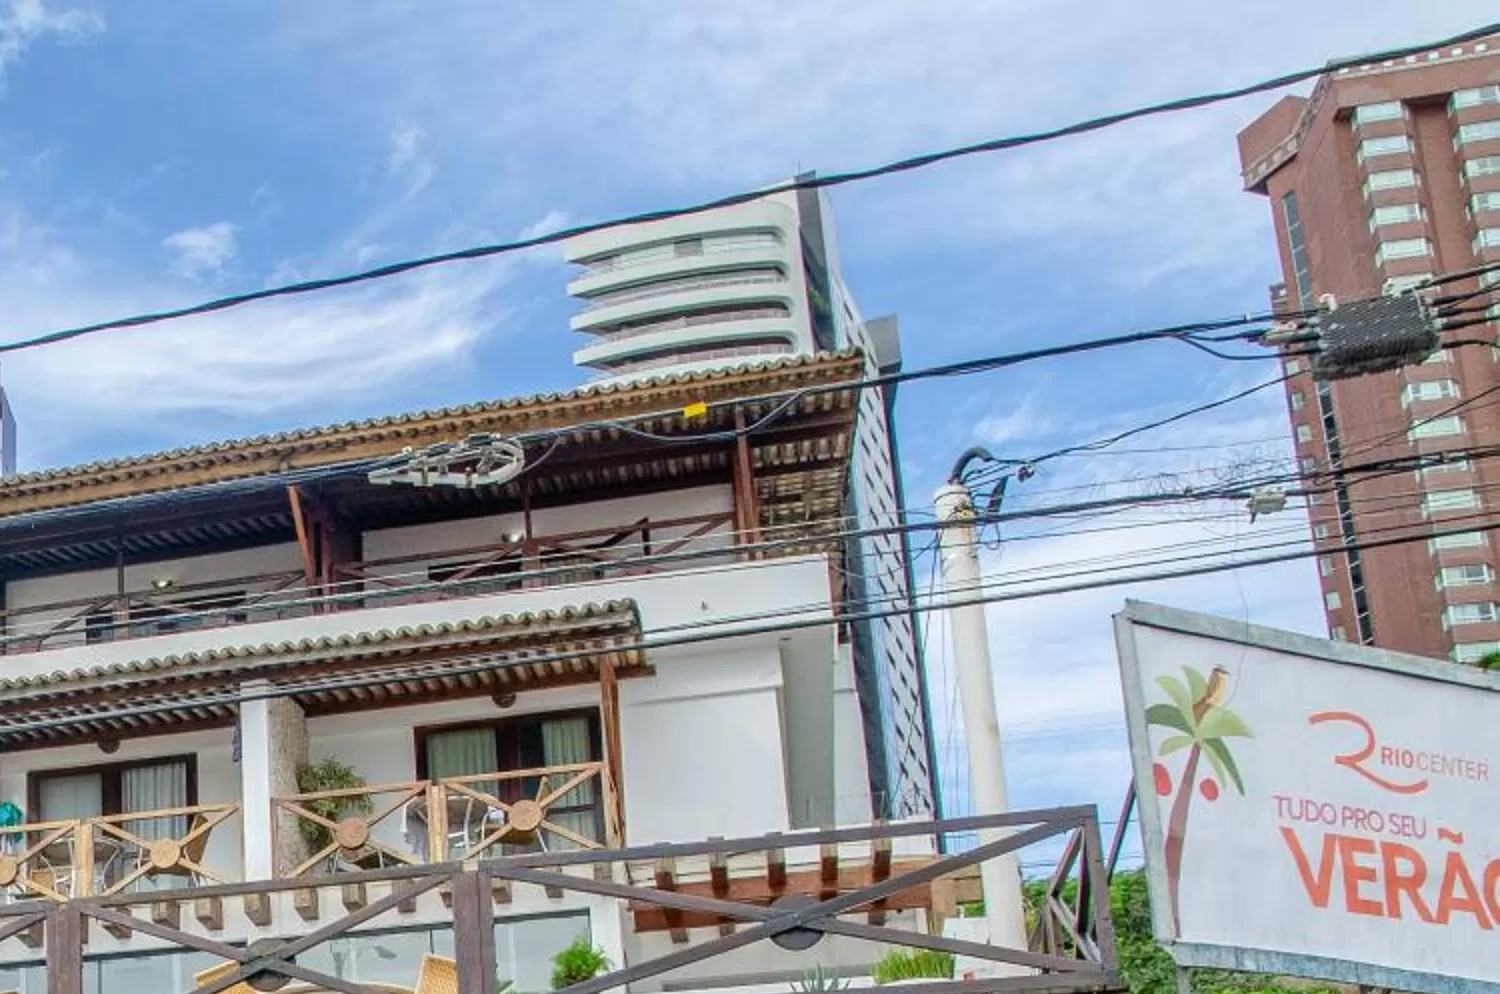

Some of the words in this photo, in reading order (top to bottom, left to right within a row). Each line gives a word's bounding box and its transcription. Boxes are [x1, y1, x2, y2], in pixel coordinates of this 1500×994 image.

[1272, 795, 1337, 825] TUDO
[1341, 806, 1385, 833] PRO
[1388, 813, 1427, 839] SEU
